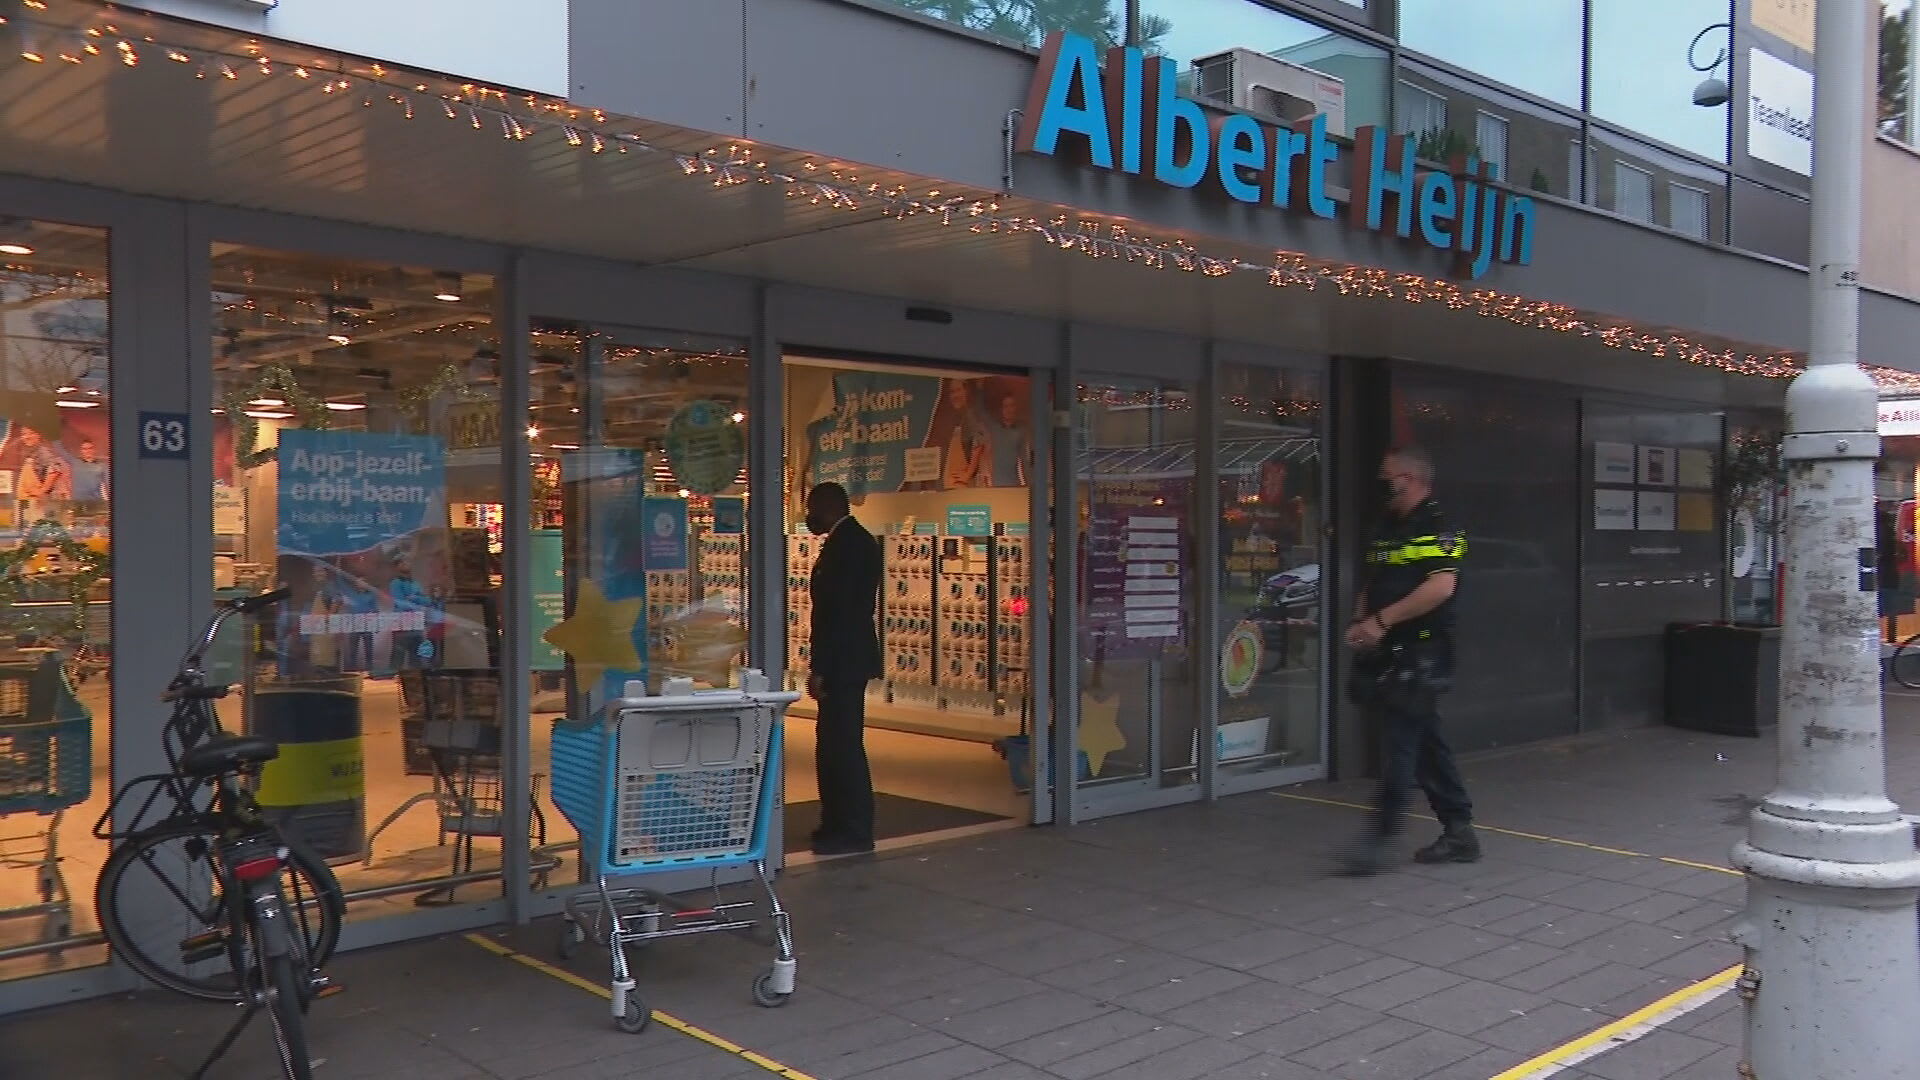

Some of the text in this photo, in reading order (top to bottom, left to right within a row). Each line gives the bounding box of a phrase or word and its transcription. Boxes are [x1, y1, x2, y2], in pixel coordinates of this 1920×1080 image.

[1751, 96, 1812, 142] Teamlead
[1030, 30, 1537, 280] Albert Heijn
[142, 420, 184, 452] 63
[290, 449, 432, 478] App-jezelf-
[291, 477, 432, 507] erbij-baan.
